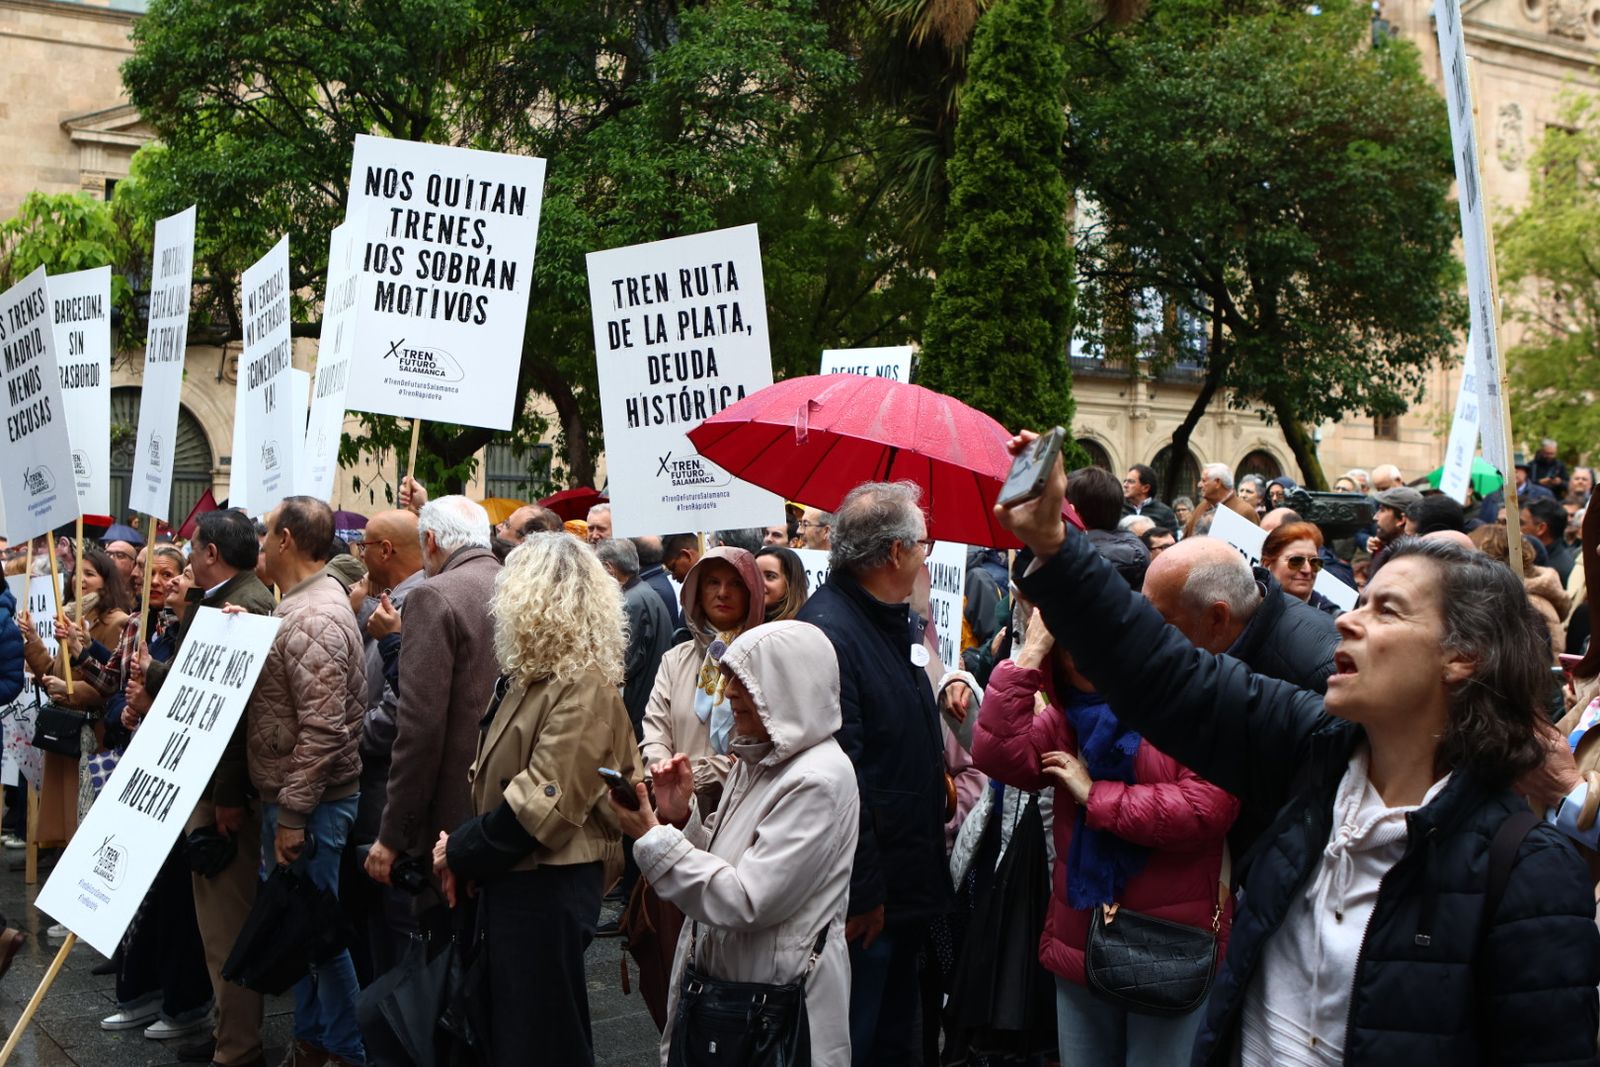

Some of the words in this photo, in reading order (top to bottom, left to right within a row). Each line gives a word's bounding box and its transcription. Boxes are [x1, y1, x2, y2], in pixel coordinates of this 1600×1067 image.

[365, 166, 414, 201] NOS
[426, 174, 527, 216] QUITAN
[390, 207, 493, 255] TRENES,
[248, 290, 257, 316] NI
[259, 267, 284, 309] EXCUSAS
[416, 250, 517, 291] SOBRAN
[612, 272, 669, 309] TREN
[679, 260, 739, 298] RUTA
[8, 287, 45, 334] TRENES
[55, 293, 105, 324] BARCELONA,
[374, 281, 488, 325] MOTIVOS
[246, 321, 255, 347] NI
[608, 318, 634, 350] DE
[644, 313, 668, 345] LA
[678, 302, 752, 341] PLATA,
[4, 327, 46, 374] MADRID,
[400, 357, 436, 369] FUTURO
[403, 349, 433, 361] TREN
[647, 347, 719, 385] DEUDA
[8, 365, 42, 407] MENOS
[59, 362, 100, 389] RASBORDO
[399, 366, 446, 378] SALAMANCA
[7, 396, 52, 442] EXCUSAS
[671, 469, 704, 479] FUTURO
[672, 459, 700, 471] TREN
[672, 476, 715, 486] SALAMANCA
[942, 600, 950, 629] ES
[180, 640, 228, 682] RENFE
[220, 649, 254, 689] NOS
[166, 685, 206, 726] DEJA
[198, 693, 226, 732] EN
[157, 727, 191, 772] VÍA
[118, 766, 181, 823] MUERTA
[104, 846, 120, 862] TREN
